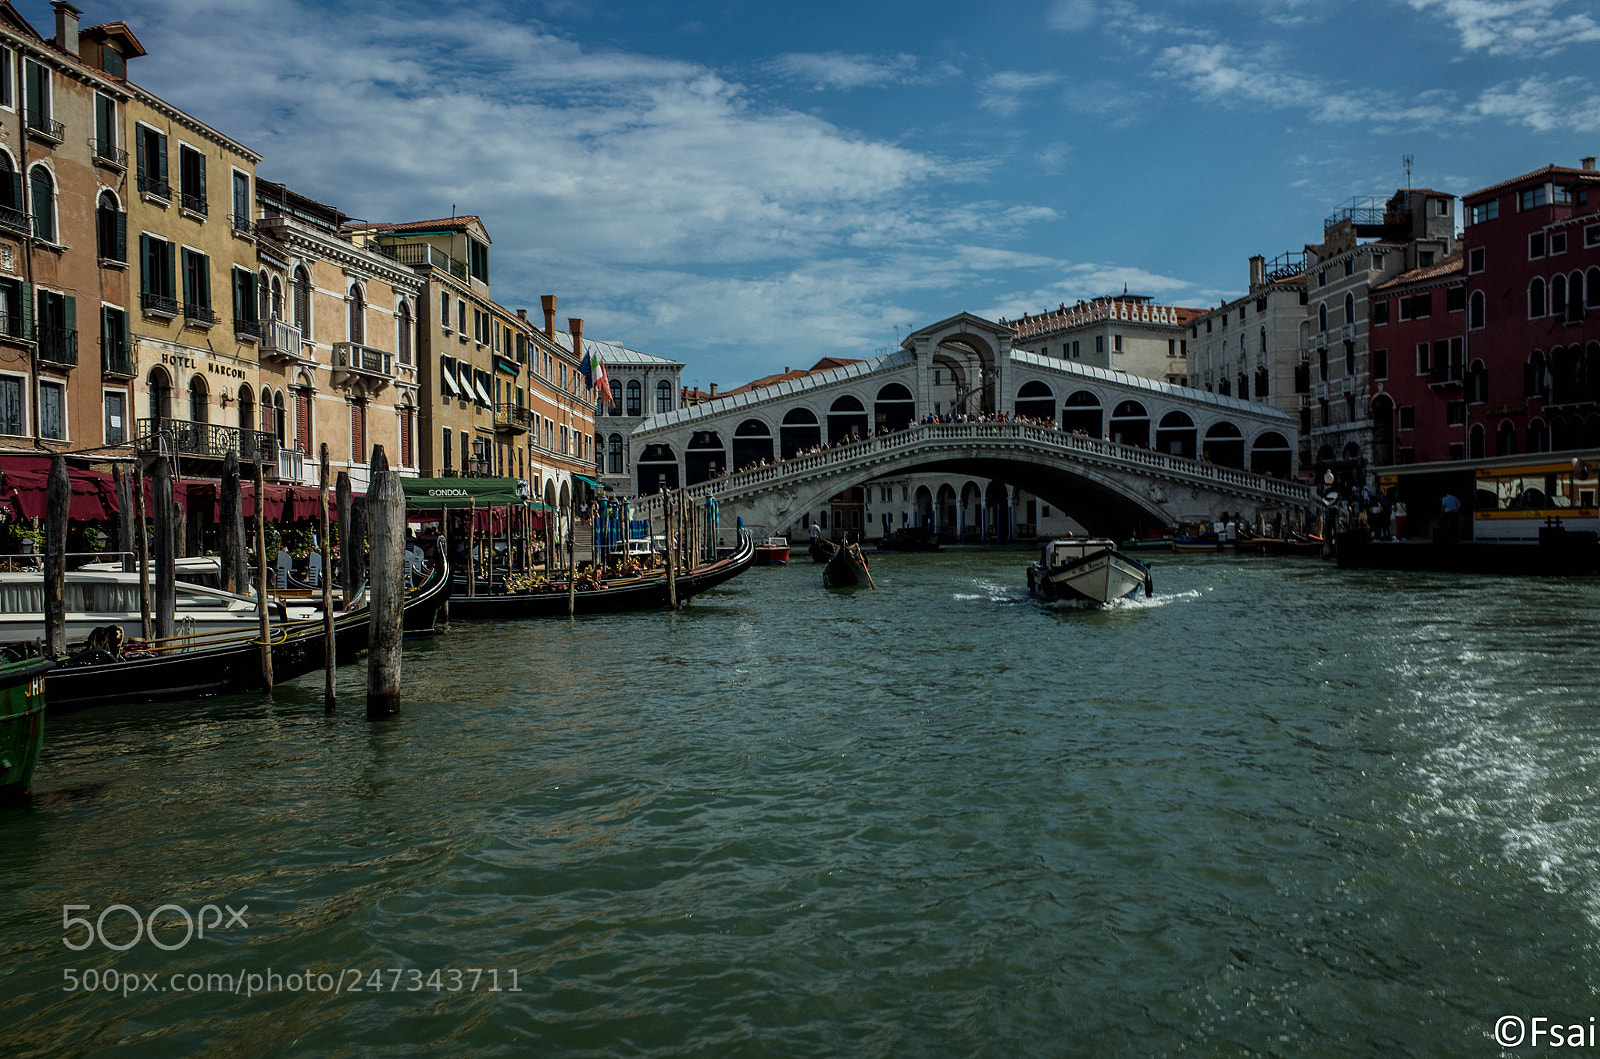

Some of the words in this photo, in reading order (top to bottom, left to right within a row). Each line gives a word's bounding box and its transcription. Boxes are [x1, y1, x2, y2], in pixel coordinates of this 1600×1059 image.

[162, 353, 197, 369] HOTEL
[208, 363, 246, 380] MARCONI
[428, 488, 468, 497] GONDOLA
